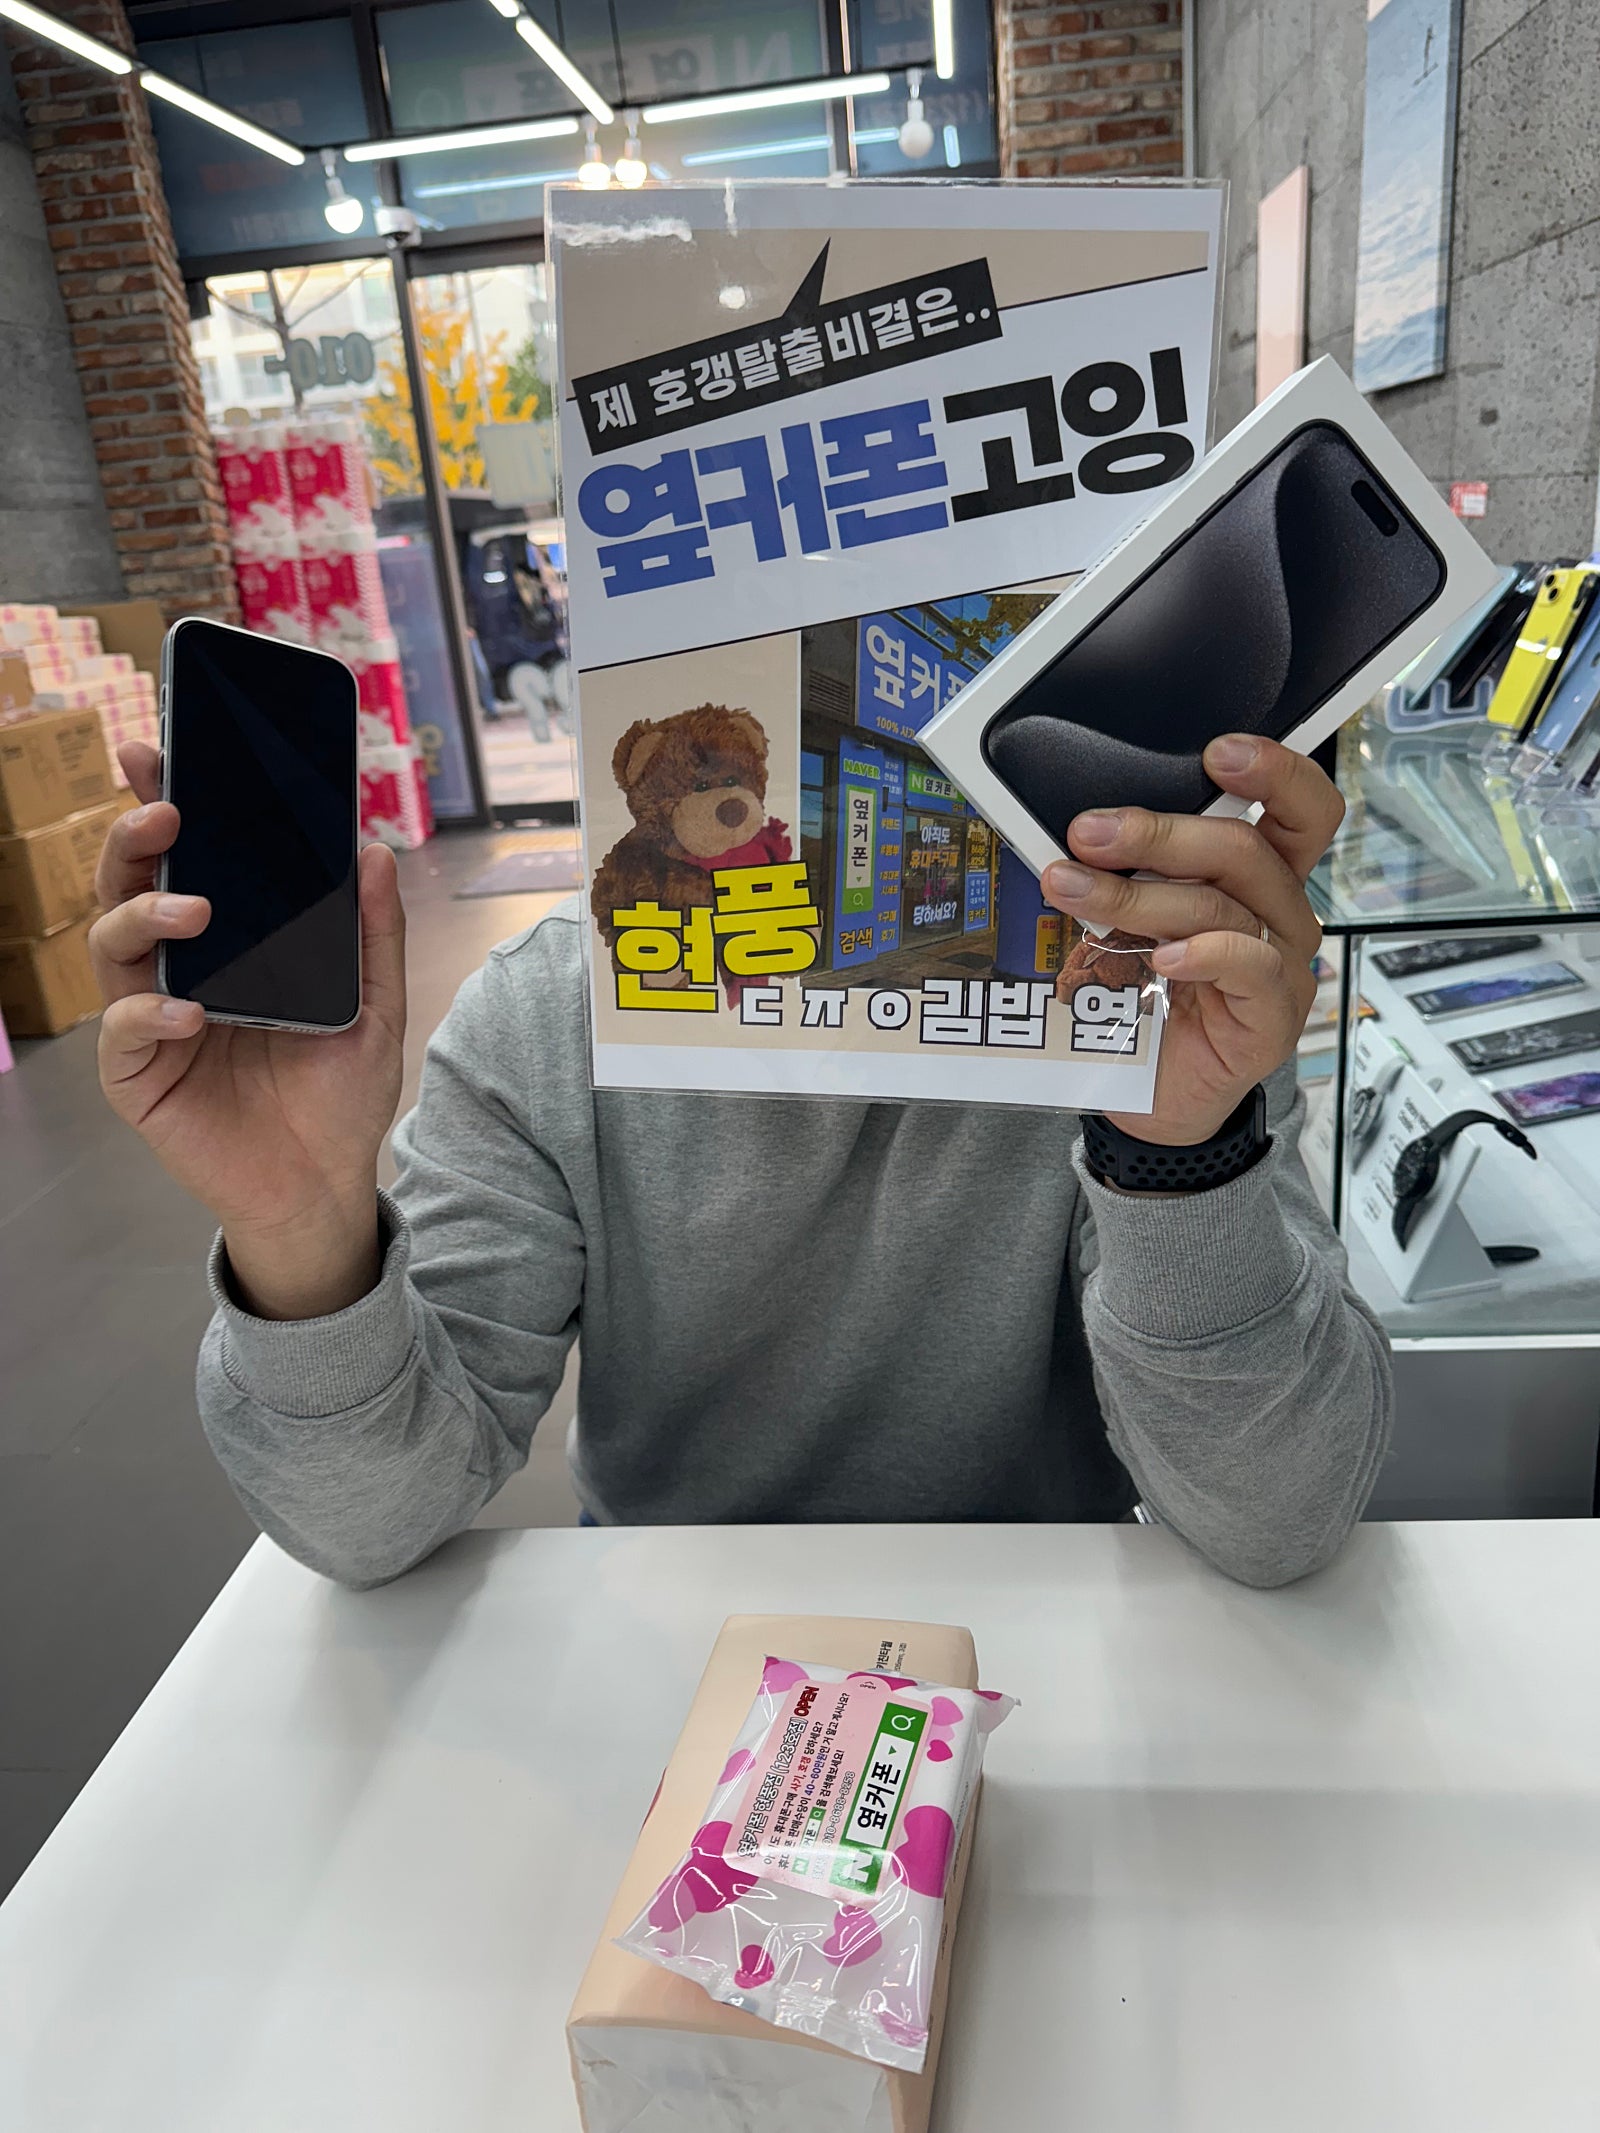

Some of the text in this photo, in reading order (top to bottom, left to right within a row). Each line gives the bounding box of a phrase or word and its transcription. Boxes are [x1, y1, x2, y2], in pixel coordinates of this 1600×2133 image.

[591, 286, 992, 434] 제 호갱탈출비결은..
[843, 758, 880, 780] NAVER
[911, 774, 952, 796] N 옆커폰
[851, 798, 869, 868] 옆커폰
[921, 825, 951, 845] 아직도
[913, 901, 958, 926] 당하세요?
[611, 861, 823, 1013] 현풍
[840, 927, 873, 955] 검색
[1070, 982, 1142, 1055] 옆
[826, 1722, 839, 1736] 알고
[831, 1692, 850, 1722] 계시나요?
[823, 1737, 834, 1746] 거
[737, 1686, 819, 1857] 옆커폰 현풍점 (123호점) OPEN
[763, 1722, 824, 1865] 아도 휴대폰구매 사기, 호갱 당하세요?
[820, 1749, 845, 1797] 검색해보세요!
[788, 1797, 811, 1838] 판매수당이
[823, 1771, 855, 1847] 010-8688-8258
[857, 1762, 901, 1830] 옆커폰
